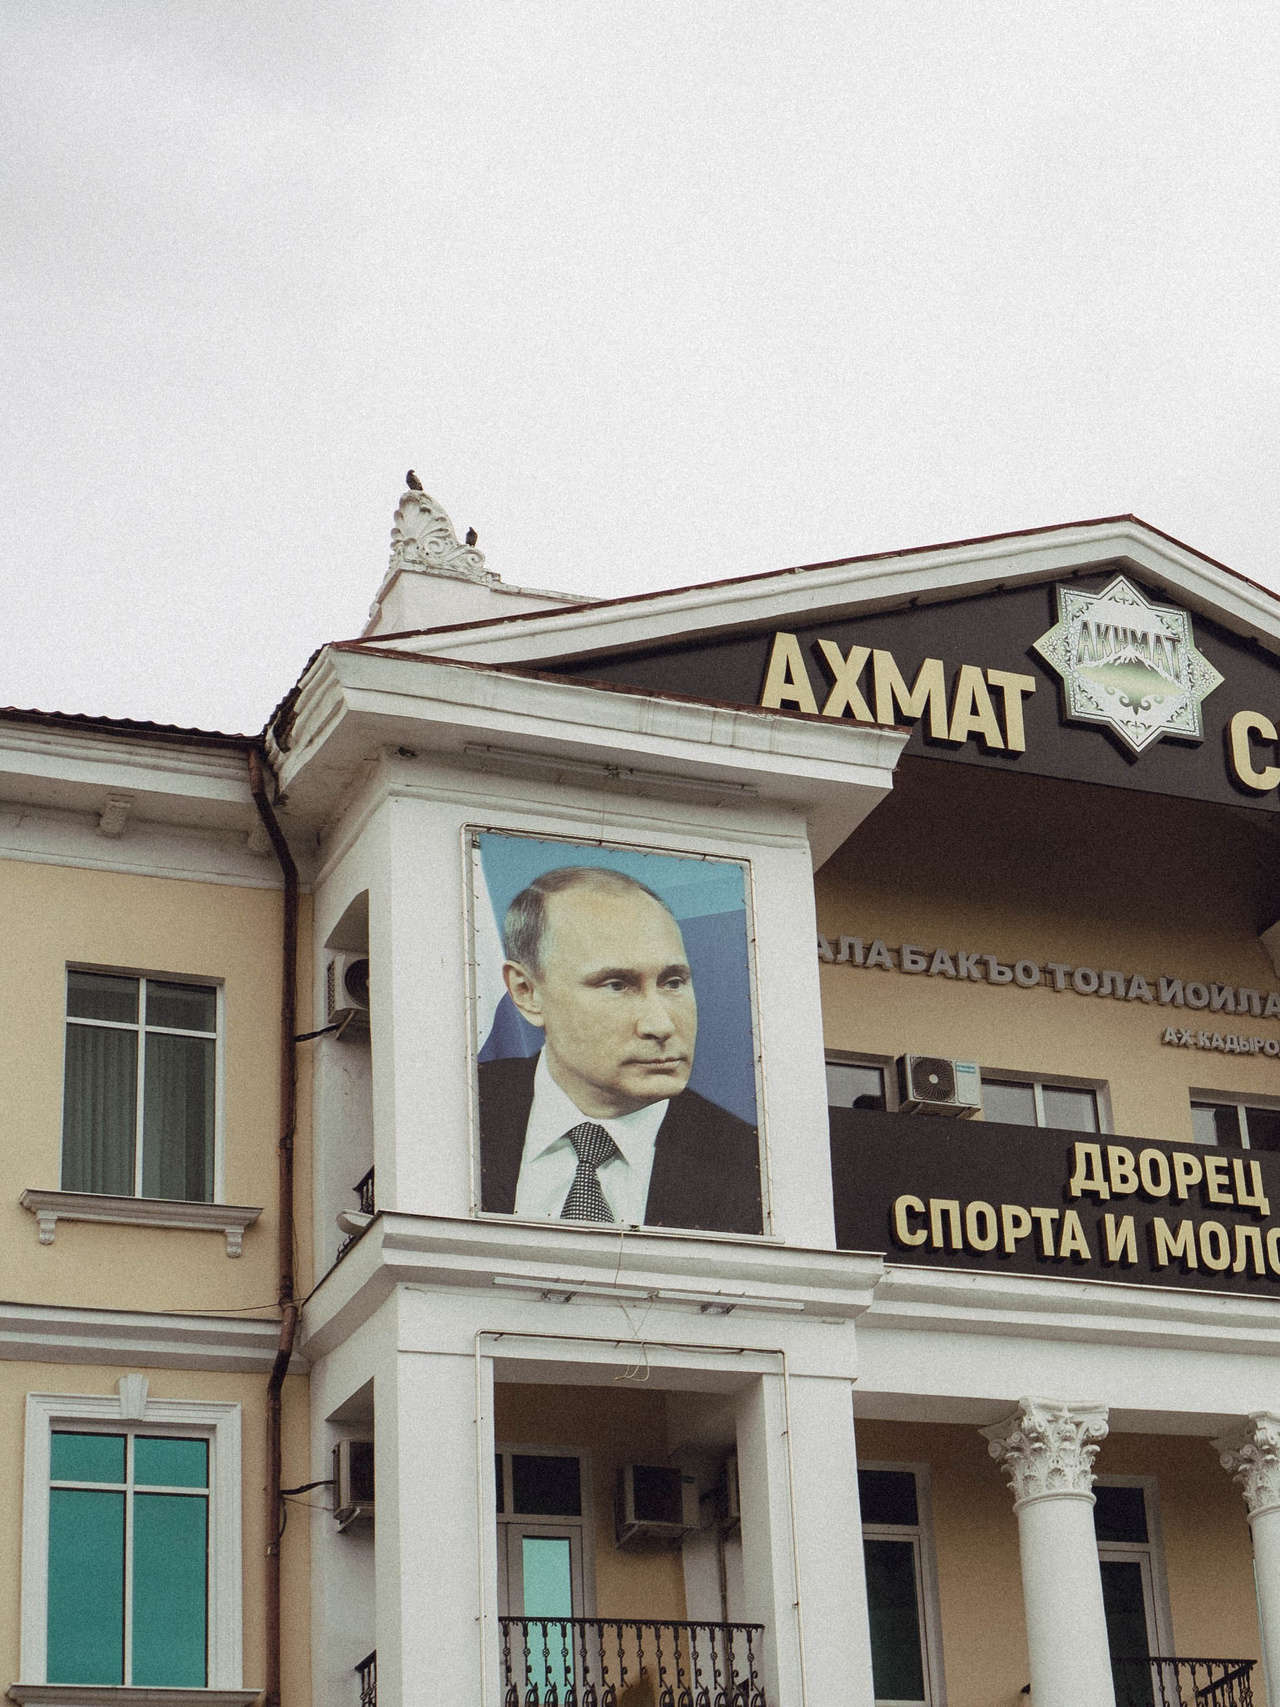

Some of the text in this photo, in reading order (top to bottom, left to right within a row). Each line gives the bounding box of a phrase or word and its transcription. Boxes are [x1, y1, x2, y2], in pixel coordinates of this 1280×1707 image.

[760, 631, 1036, 752] АХМАТ
[901, 943, 1041, 988] БАКЪО
[1047, 962, 1153, 1003] ТОЛА
[1069, 1142, 1271, 1216] ДВОРЕЦ
[894, 1194, 1092, 1259] СПОРТА
[1104, 1213, 1138, 1263] И
